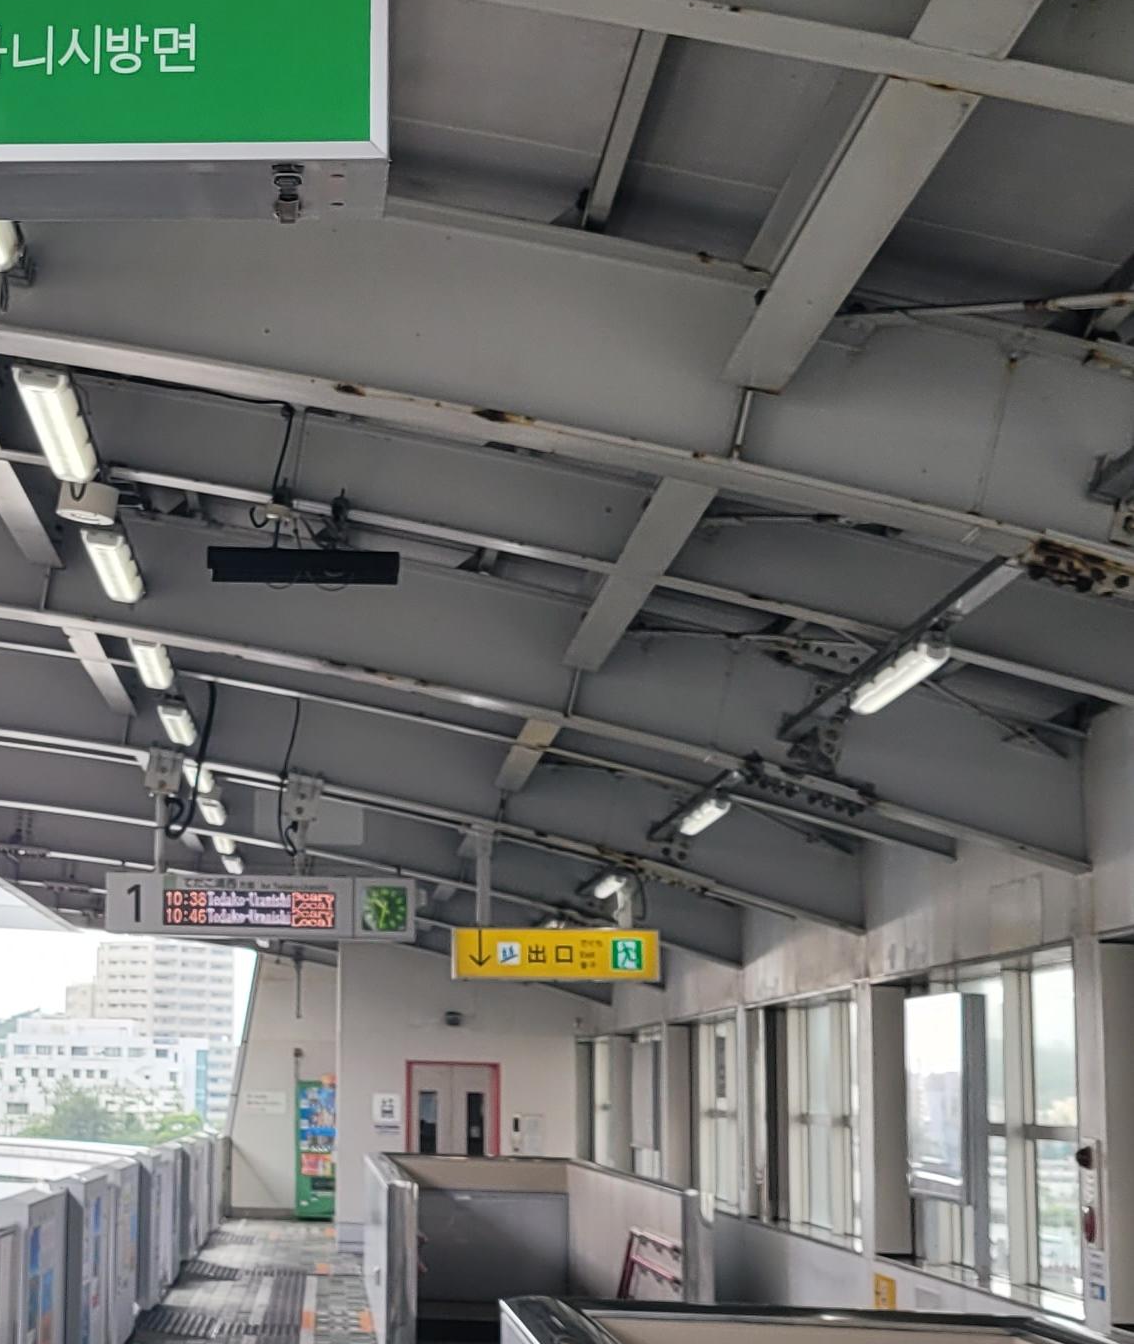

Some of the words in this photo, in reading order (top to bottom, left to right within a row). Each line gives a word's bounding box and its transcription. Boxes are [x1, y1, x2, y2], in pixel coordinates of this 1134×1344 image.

[126, 883, 142, 923] 1
[165, 890, 207, 907] 10:38
[165, 908, 207, 925] 10:46
[528, 944, 573, 964] 出口
